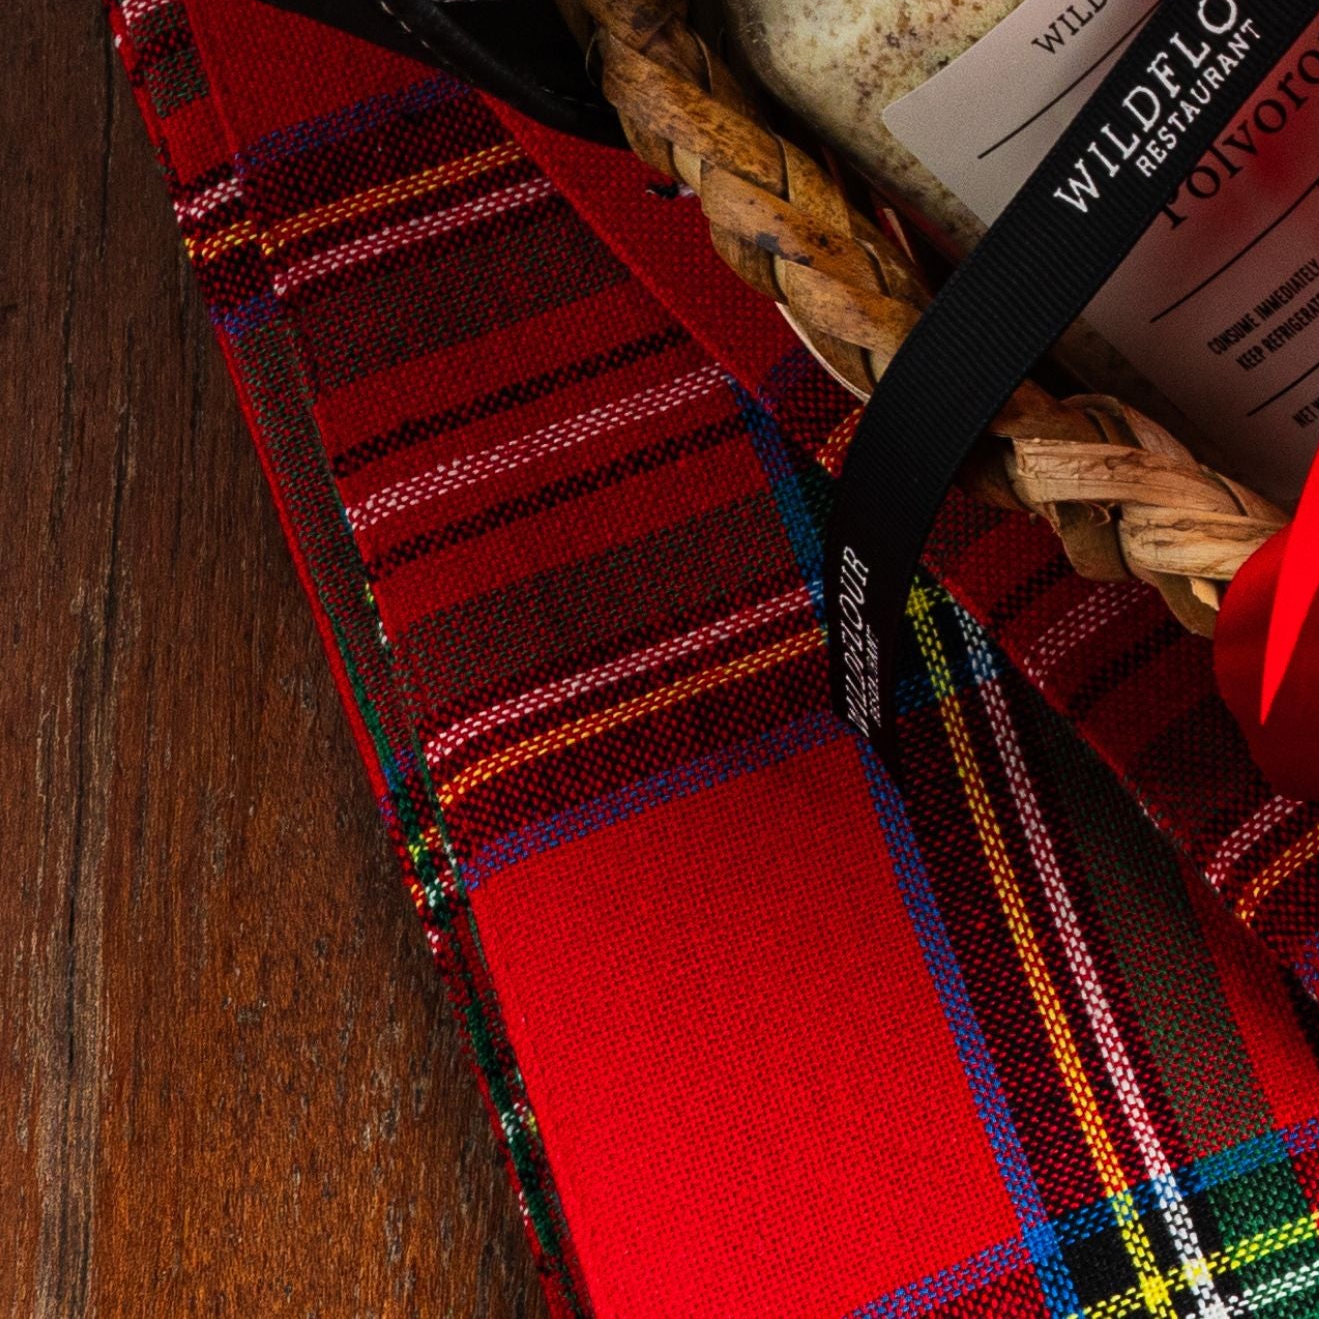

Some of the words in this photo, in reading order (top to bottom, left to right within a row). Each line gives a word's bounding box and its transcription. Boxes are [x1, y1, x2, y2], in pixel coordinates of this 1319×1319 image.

[1136, 18, 1260, 177] RESTAURANT
[1207, 313, 1260, 355] CONSUME
[1236, 345, 1266, 371] KEEP
[1292, 406, 1318, 428] NET
